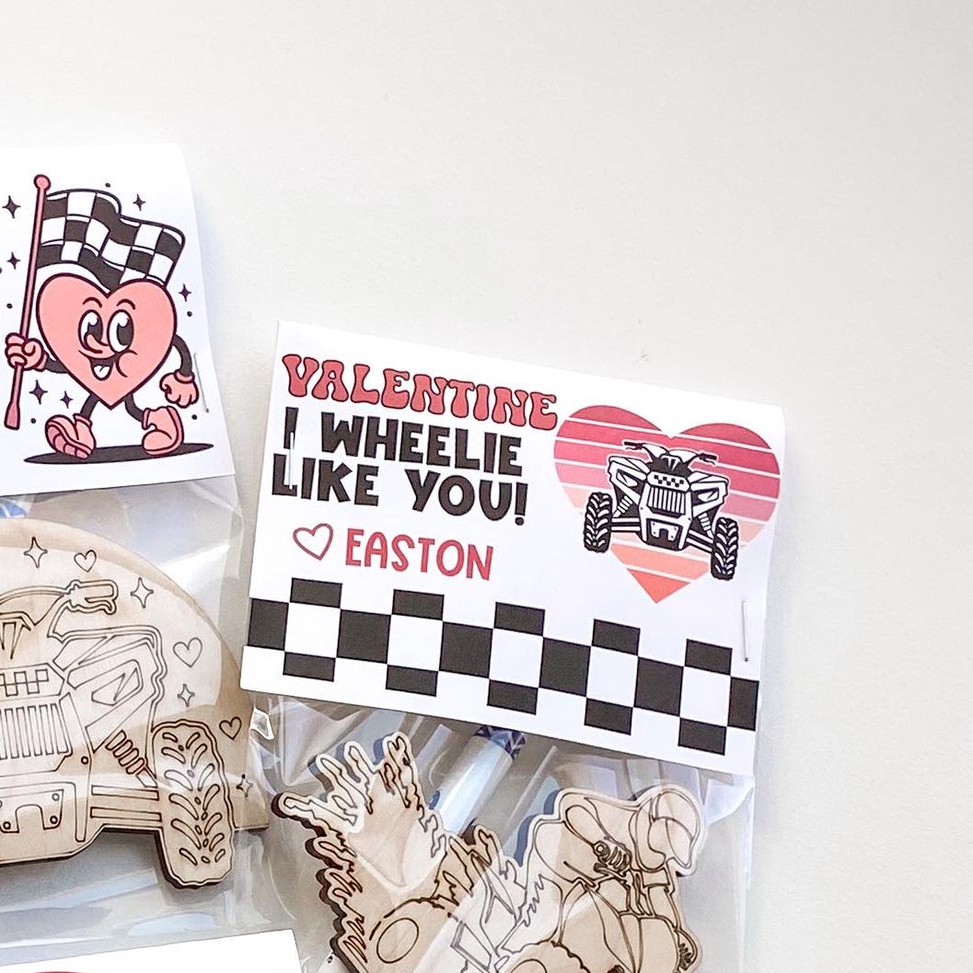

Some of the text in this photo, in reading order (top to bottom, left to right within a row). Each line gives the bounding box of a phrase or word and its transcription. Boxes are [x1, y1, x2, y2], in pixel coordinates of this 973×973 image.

[282, 353, 558, 431] VALENTINE
[283, 406, 523, 477] I WHEELIE
[271, 453, 528, 526] LIKE YOU!
[345, 528, 494, 581] EASTON
